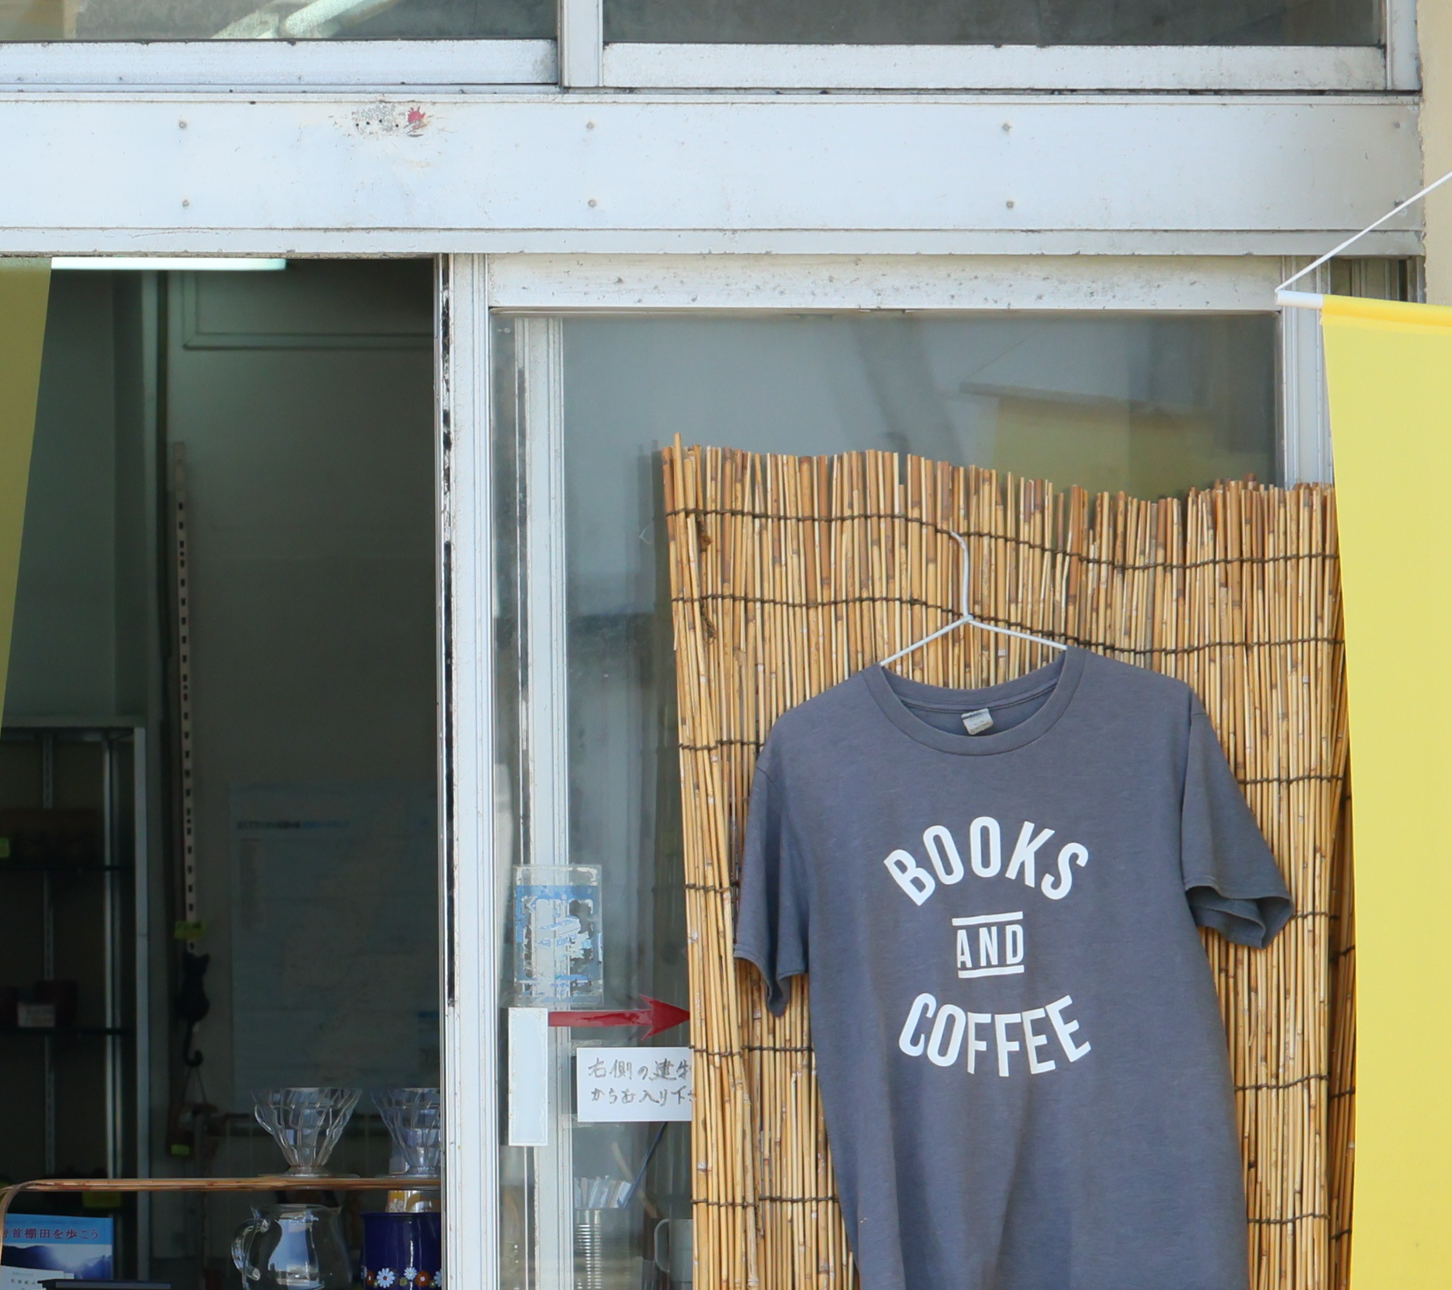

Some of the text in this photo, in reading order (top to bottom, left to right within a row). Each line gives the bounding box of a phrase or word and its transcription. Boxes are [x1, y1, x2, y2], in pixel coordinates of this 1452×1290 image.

[884, 816, 1088, 906] BOOKS
[957, 924, 1024, 968] AND
[899, 993, 1091, 1077] COFFEE
